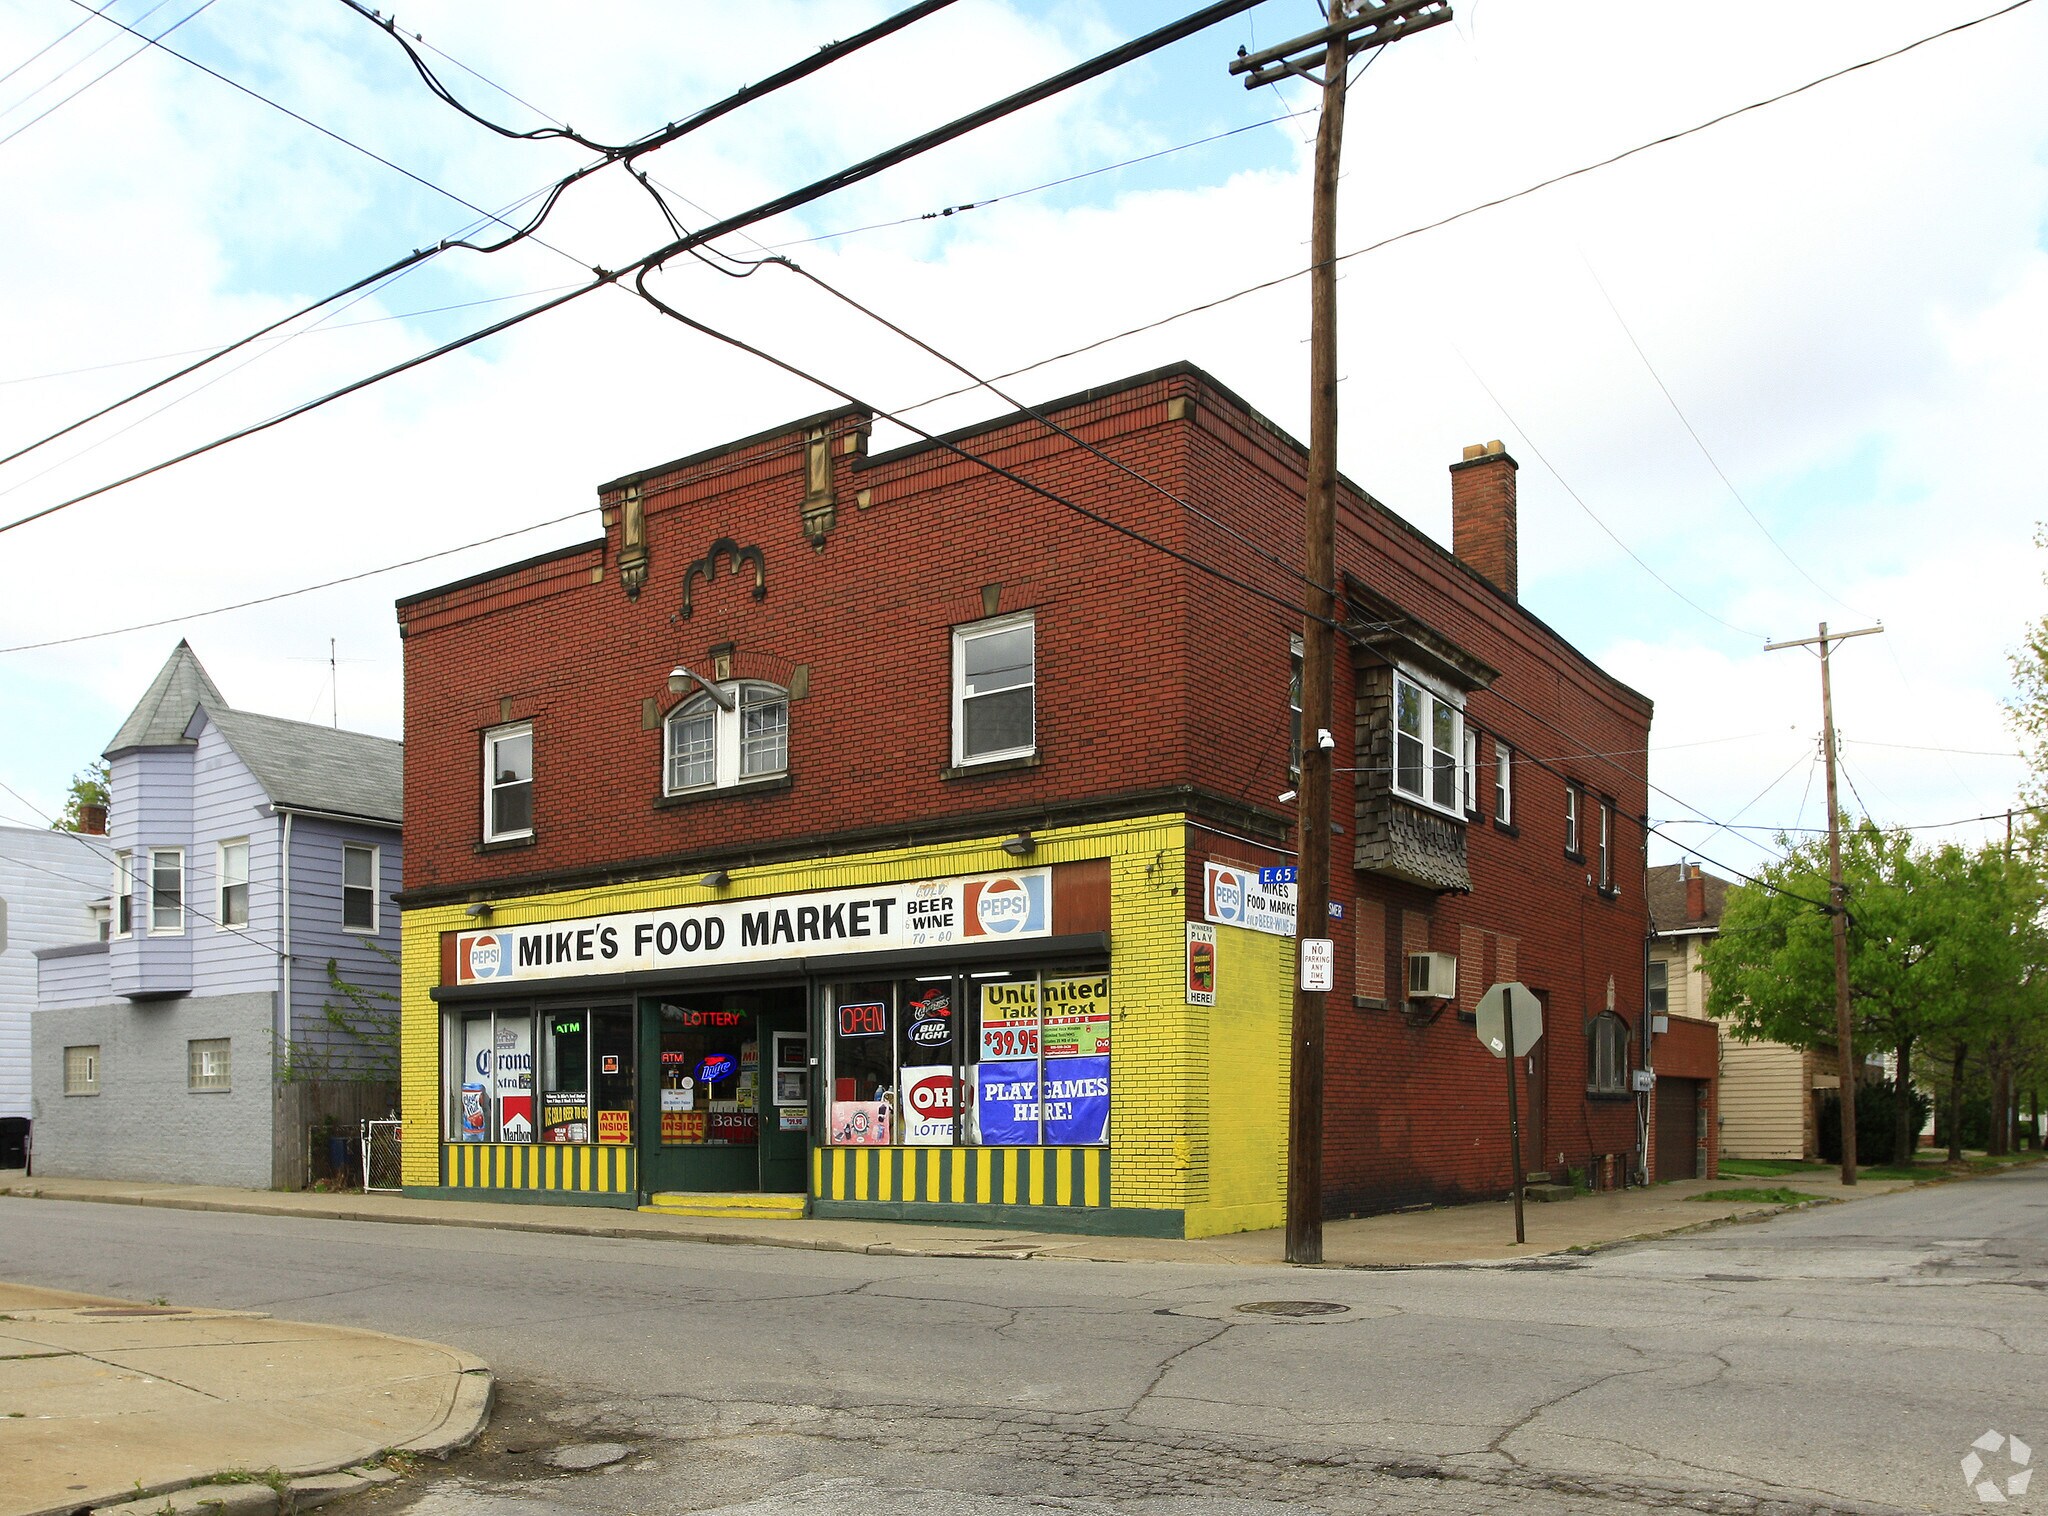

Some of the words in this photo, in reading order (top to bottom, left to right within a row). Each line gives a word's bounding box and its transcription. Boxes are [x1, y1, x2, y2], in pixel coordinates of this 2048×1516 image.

[1264, 870, 1273, 882] E.
[1276, 869, 1297, 882] 65
[915, 884, 946, 898] COLD
[1216, 886, 1240, 906] PEPSI
[1261, 883, 1289, 898] MIKES
[907, 897, 954, 915] BEER
[979, 897, 1027, 917] PEPSI
[1246, 894, 1266, 910] FOOD
[1269, 900, 1298, 917] MARKE
[912, 914, 954, 930] WINE
[1191, 923, 1213, 933] WINNERS
[519, 924, 619, 967] MIKE'S
[634, 916, 724, 958] FOOD
[740, 898, 896, 948] MARKET
[1191, 931, 1213, 943] PLAY
[471, 948, 500, 965] PEPSI
[1311, 945, 1324, 955] NO
[1304, 955, 1330, 964] PARKING
[988, 978, 1108, 1005] Unlimited
[1191, 993, 1213, 1003] HERE!
[1000, 1005, 1038, 1019] Talk
[1057, 1001, 1096, 1016] Text
[683, 1011, 741, 1026] LOTTERY
[841, 1006, 883, 1034] OPEN
[1006, 1016, 1090, 1027] NATINWIDE
[555, 1022, 580, 1034] ATM
[919, 1023, 946, 1032] BUD
[914, 1031, 951, 1041] LIGHT
[984, 1029, 1039, 1056] $39.95
[476, 1048, 531, 1079] Crona
[661, 1053, 683, 1064] ATM
[497, 1076, 518, 1090] xtra
[984, 1082, 1036, 1102] PLAY
[1044, 1078, 1109, 1100] GAMES
[563, 1106, 574, 1121] BEER
[600, 1112, 628, 1121] ATM
[663, 1112, 703, 1121] ATM
[1013, 1101, 1073, 1121] HERE!
[600, 1122, 629, 1131] INSIDE
[662, 1121, 703, 1131] INSIDE
[712, 1113, 757, 1128] Basic
[502, 1124, 532, 1142] Marlbor
[914, 1123, 964, 1138] LOTTE
